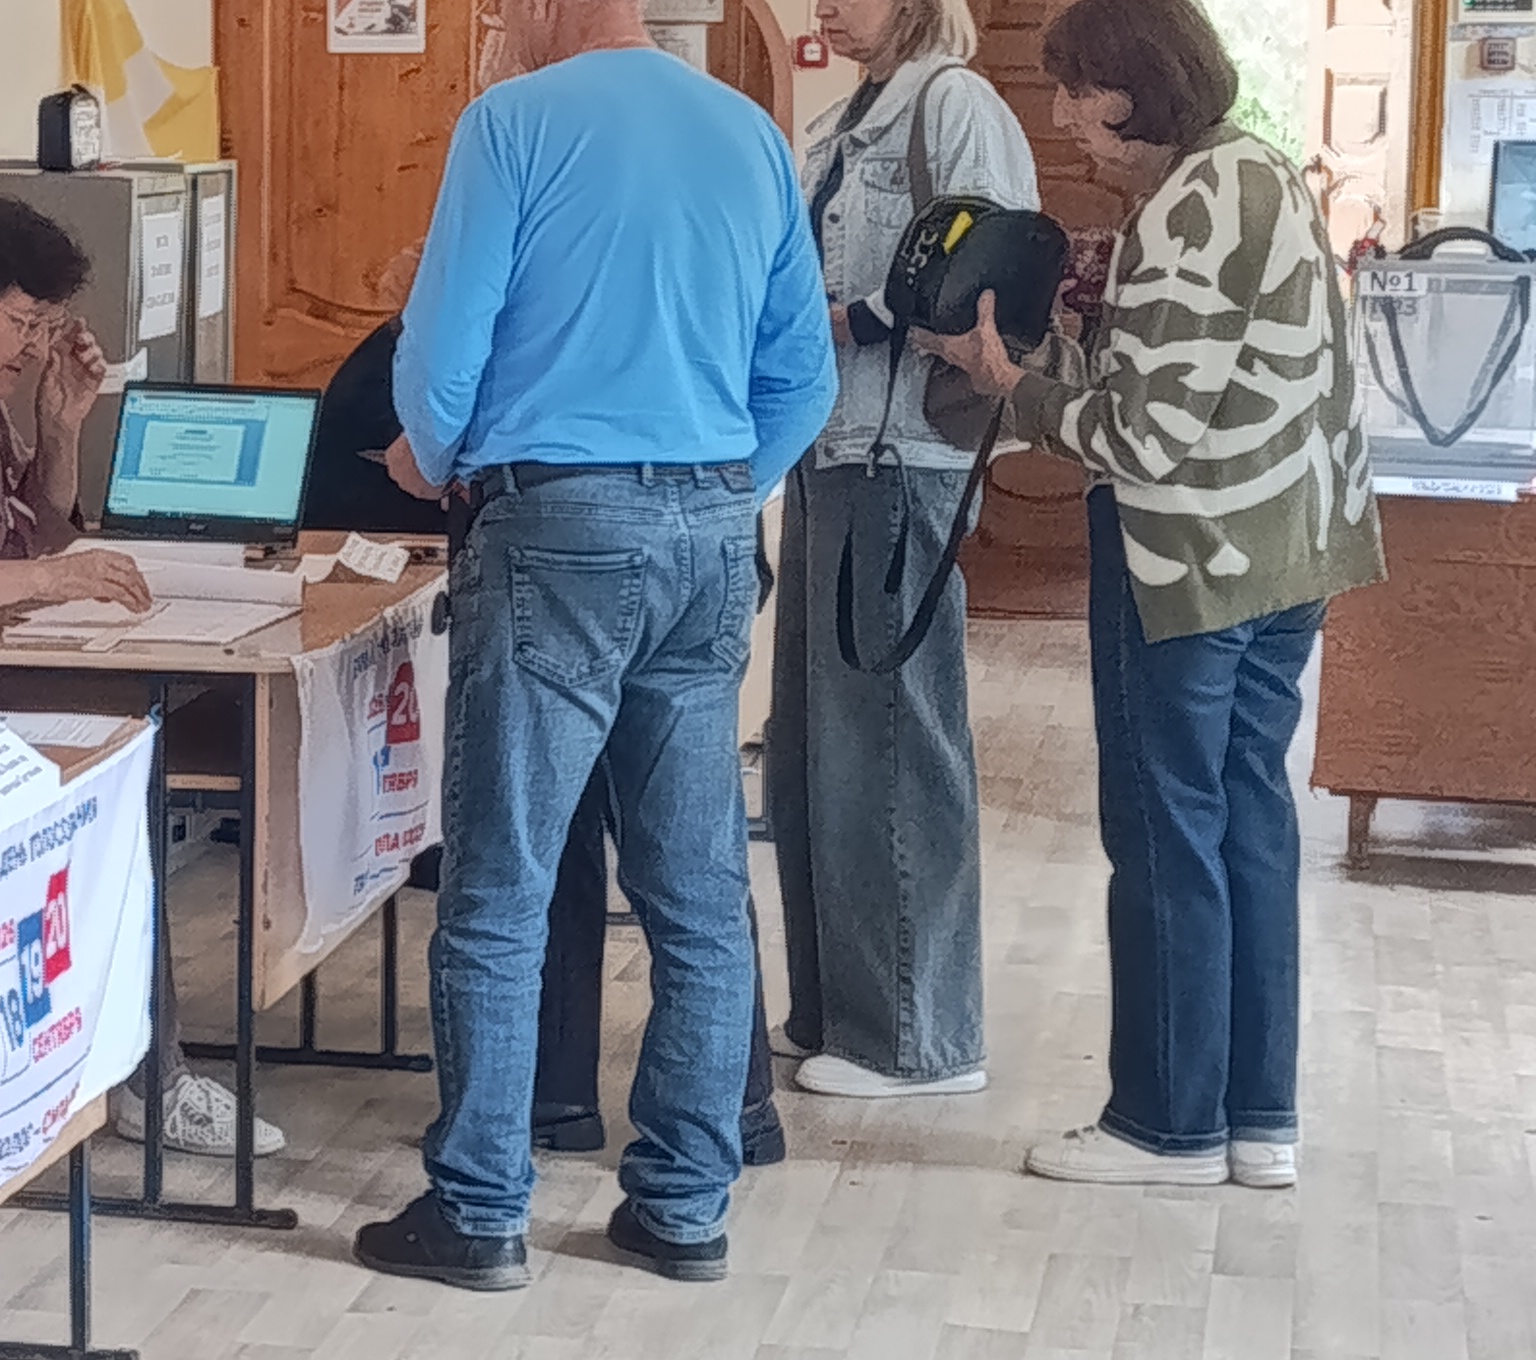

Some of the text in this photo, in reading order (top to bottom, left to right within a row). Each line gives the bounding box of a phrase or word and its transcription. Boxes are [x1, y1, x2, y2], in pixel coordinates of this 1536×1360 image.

[1370, 271, 1418, 292] №1
[21, 938, 44, 1005] 19
[46, 891, 69, 959] 20
